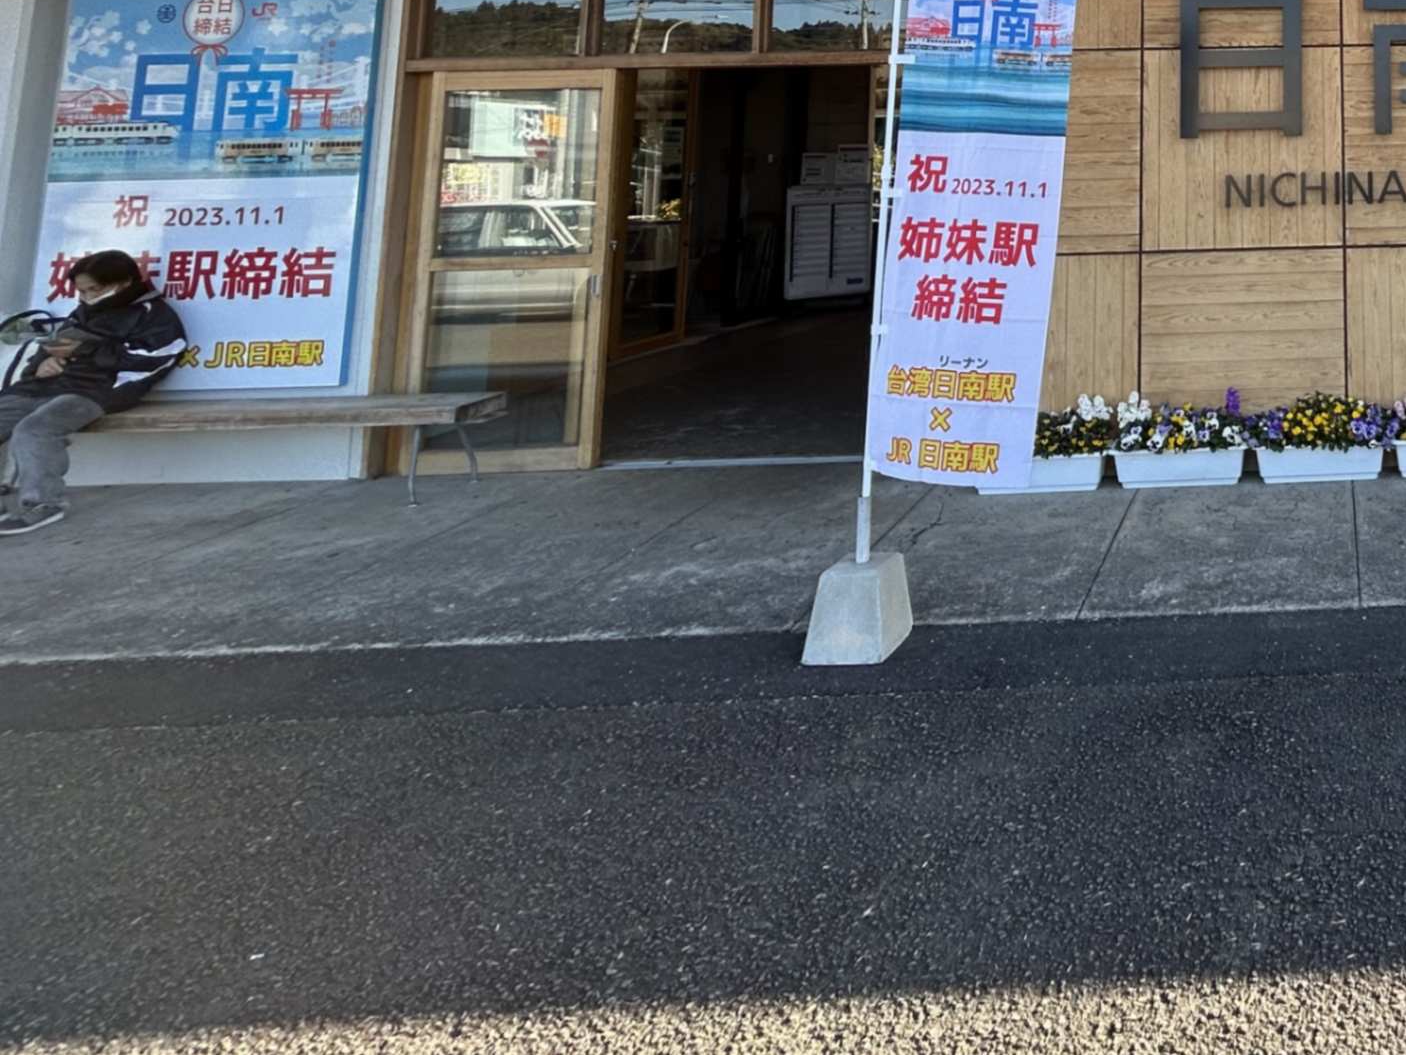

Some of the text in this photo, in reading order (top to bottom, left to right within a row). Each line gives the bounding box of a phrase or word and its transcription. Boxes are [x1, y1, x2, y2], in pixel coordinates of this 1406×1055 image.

[193, 17, 232, 37] 締結
[252, 2, 278, 17] JR
[130, 49, 298, 141] 日南
[907, 153, 1048, 199] 祝 2023.11.1
[113, 194, 286, 228] 祝 2023.11.1
[897, 216, 1040, 267] 姉妹駅
[911, 274, 1008, 325] 締結
[204, 339, 325, 369] JR日南駅
[940, 355, 988, 369] リーナン
[886, 364, 1017, 403] 台湾日南駅
